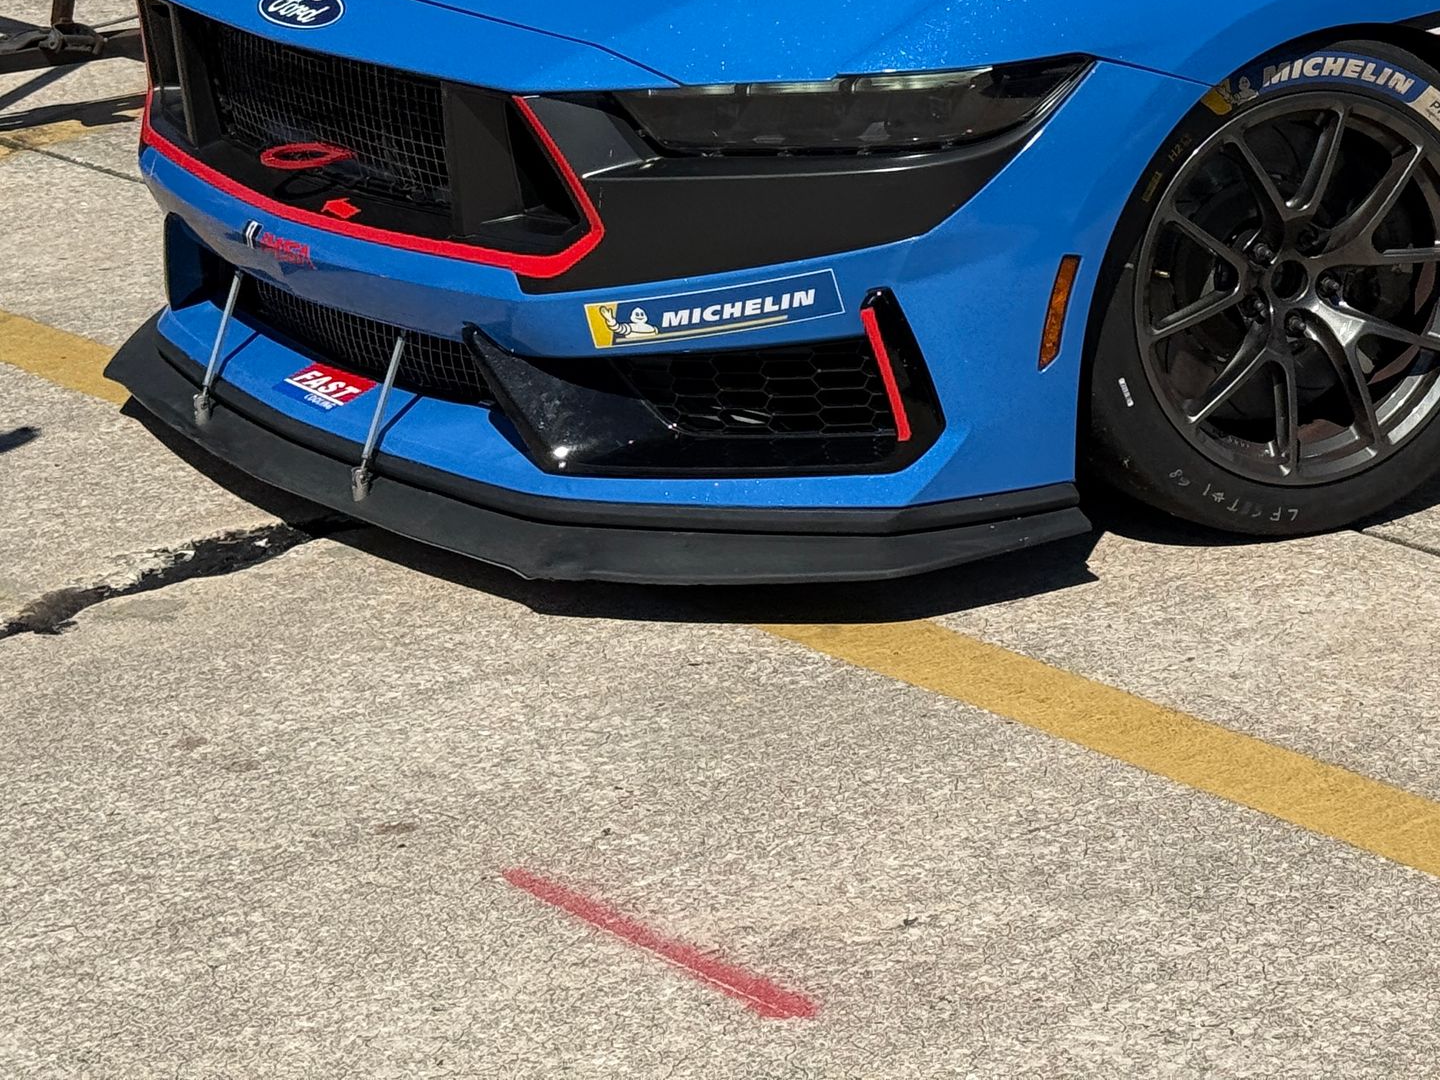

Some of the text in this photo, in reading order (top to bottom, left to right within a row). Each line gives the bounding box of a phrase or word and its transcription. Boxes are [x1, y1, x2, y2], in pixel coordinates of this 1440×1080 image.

[1262, 55, 1415, 95] MICHELIN
[661, 289, 816, 328] MICHELIN
[293, 370, 363, 399] FAST
